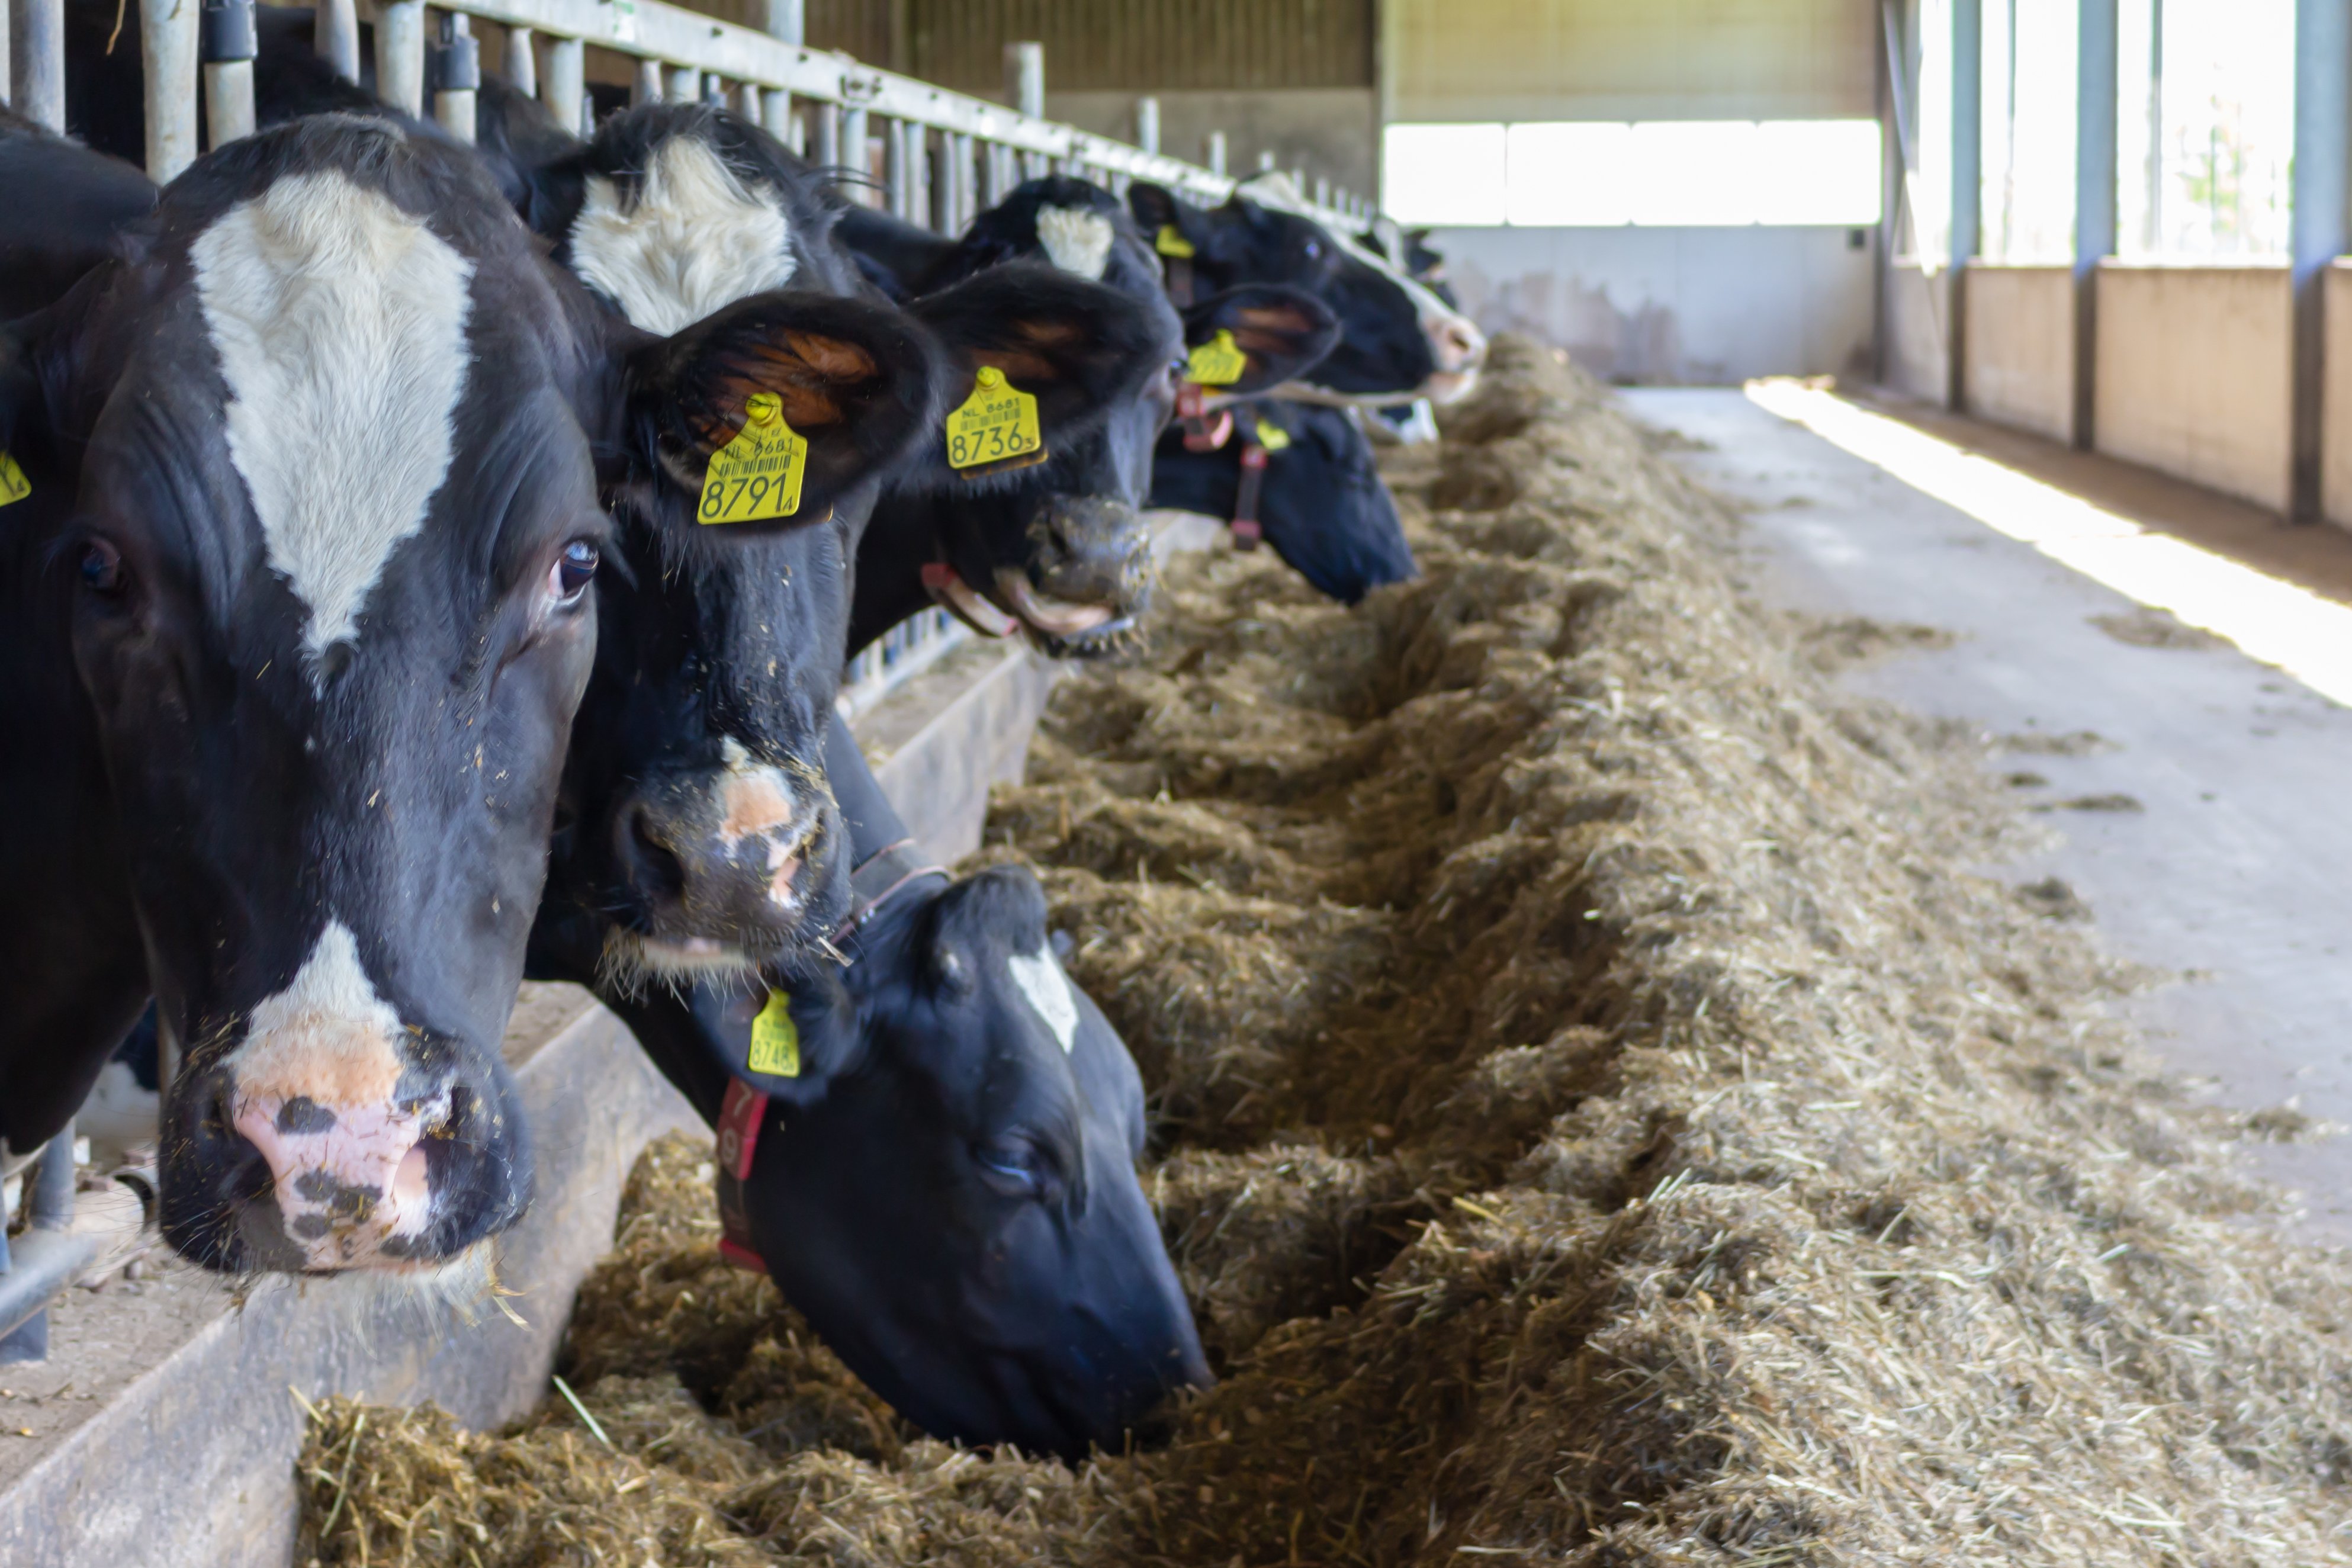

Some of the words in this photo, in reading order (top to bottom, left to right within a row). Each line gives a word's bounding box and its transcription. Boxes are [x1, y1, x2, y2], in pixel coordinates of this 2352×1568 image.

[987, 398, 1020, 413] 8681
[952, 422, 1023, 464] 8736
[701, 473, 786, 518] 8791
